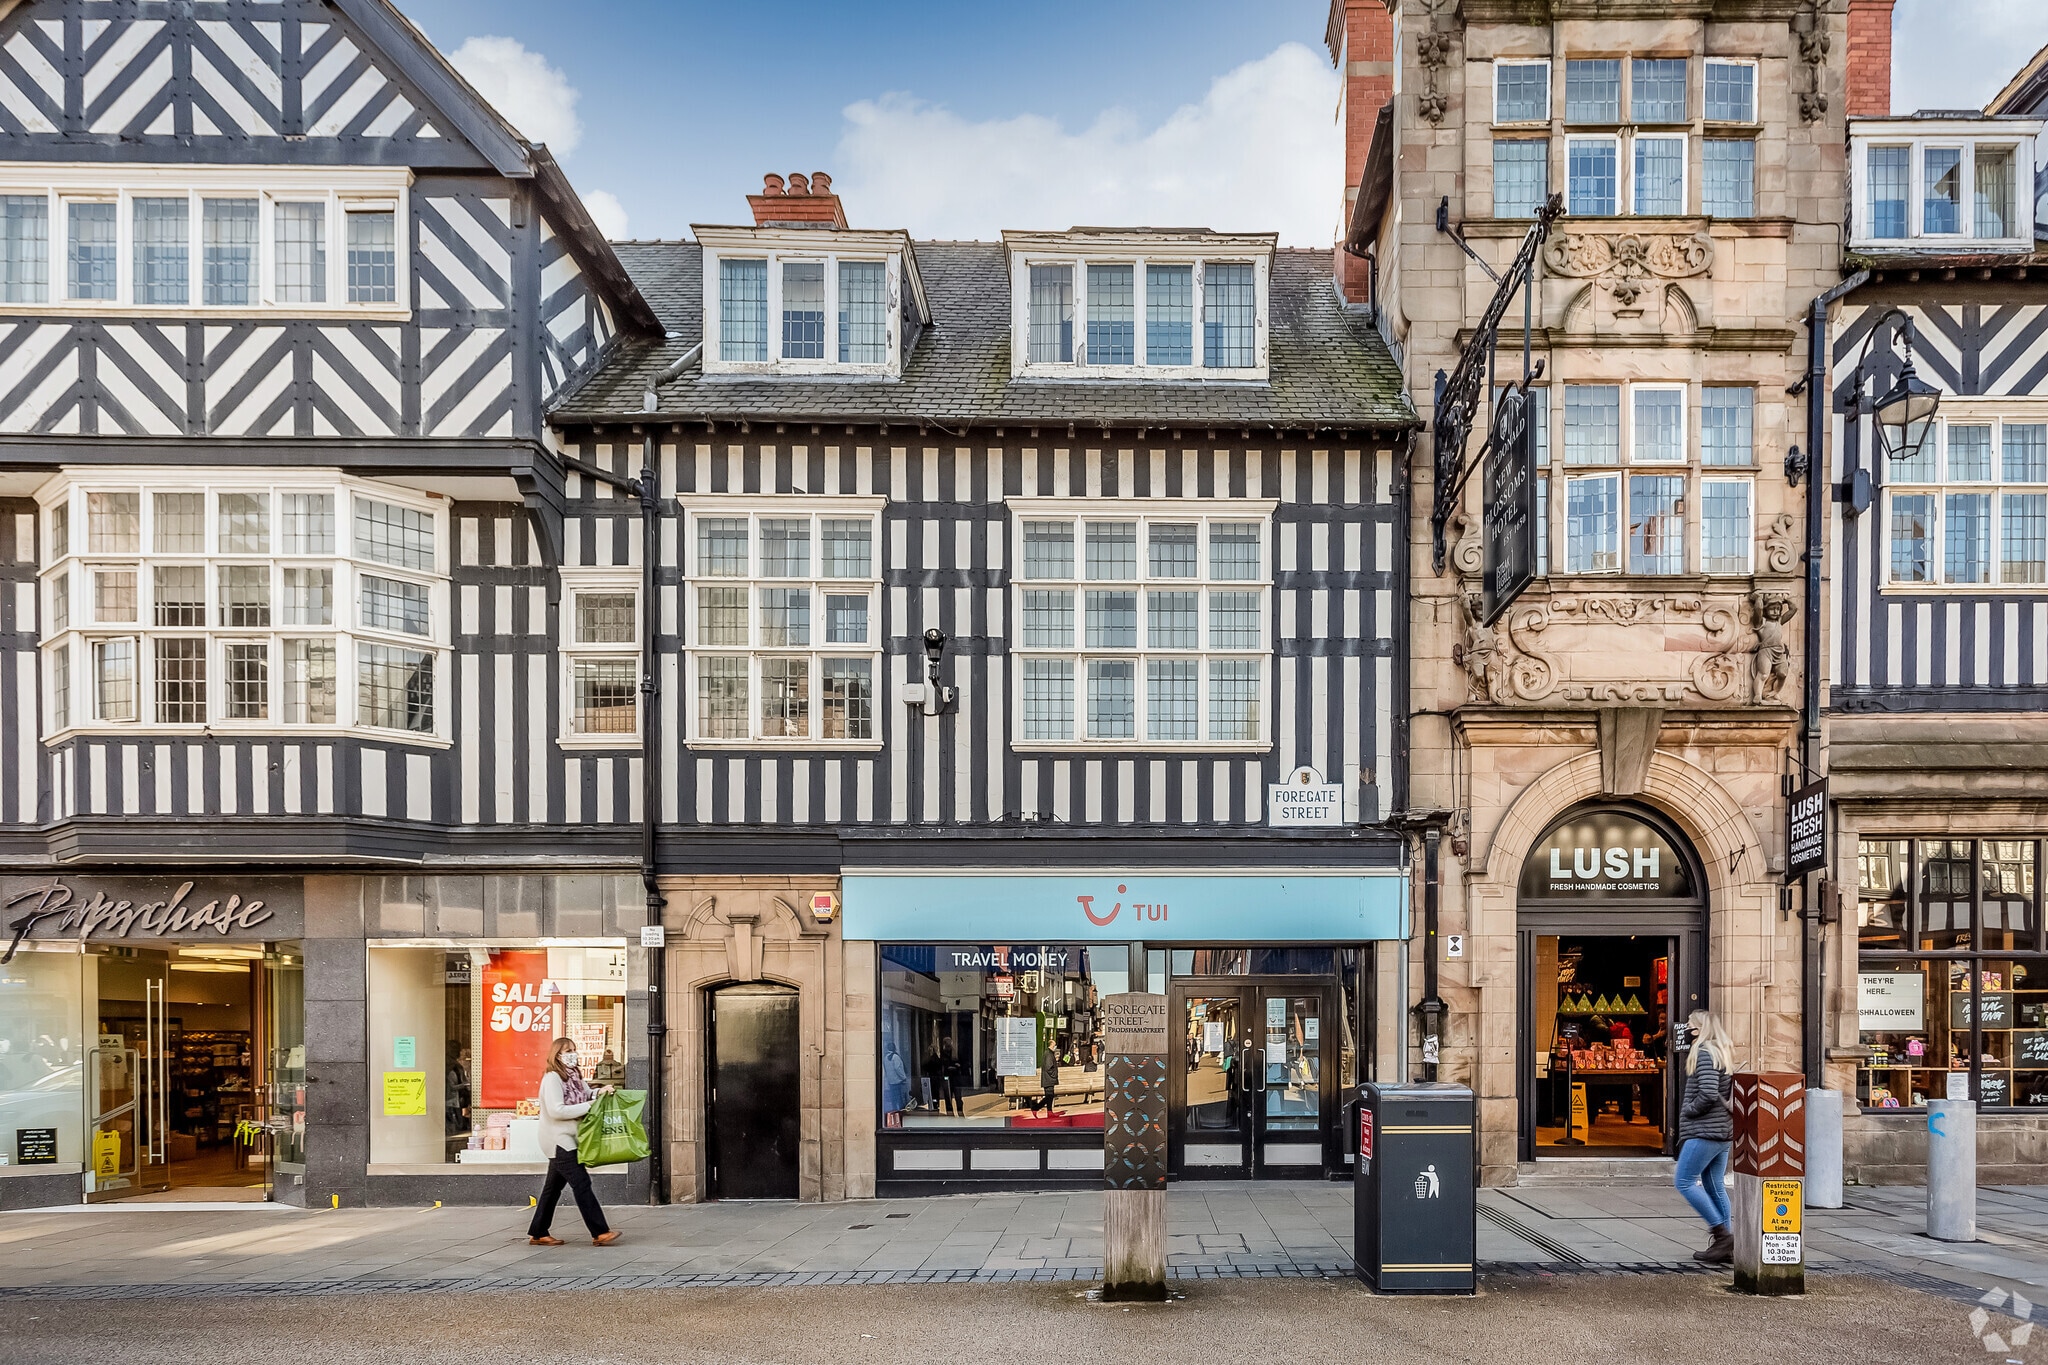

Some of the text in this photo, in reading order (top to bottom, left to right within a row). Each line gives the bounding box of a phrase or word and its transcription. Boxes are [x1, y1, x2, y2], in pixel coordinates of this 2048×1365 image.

[1485, 417, 1525, 483] MACDONALD
[1496, 458, 1512, 494] NEW
[1485, 465, 1525, 529] BLOSSOMS
[1492, 500, 1518, 542] HOTEL
[1275, 790, 1336, 803] FOREGATE
[1791, 791, 1823, 823] LUSH
[1282, 806, 1329, 819] STREET
[1791, 813, 1823, 842] FRESH
[1790, 832, 1822, 854] HANDMADE
[1550, 847, 1660, 879] LUSH
[1790, 845, 1822, 865] COSMETICS
[1550, 883, 1660, 891] FRESH HANDMADE COSMETICS
[1, 877, 274, 964] Paperchase
[1132, 904, 1168, 921] TUI
[951, 952, 1068, 967] TRAVEL MONEY
[491, 982, 552, 1003] SALE
[490, 1005, 552, 1033] 50%
[1108, 1004, 1166, 1015] FOREGATE
[531, 1023, 551, 1032] OFF
[1775, 1234, 1799, 1242] loading
